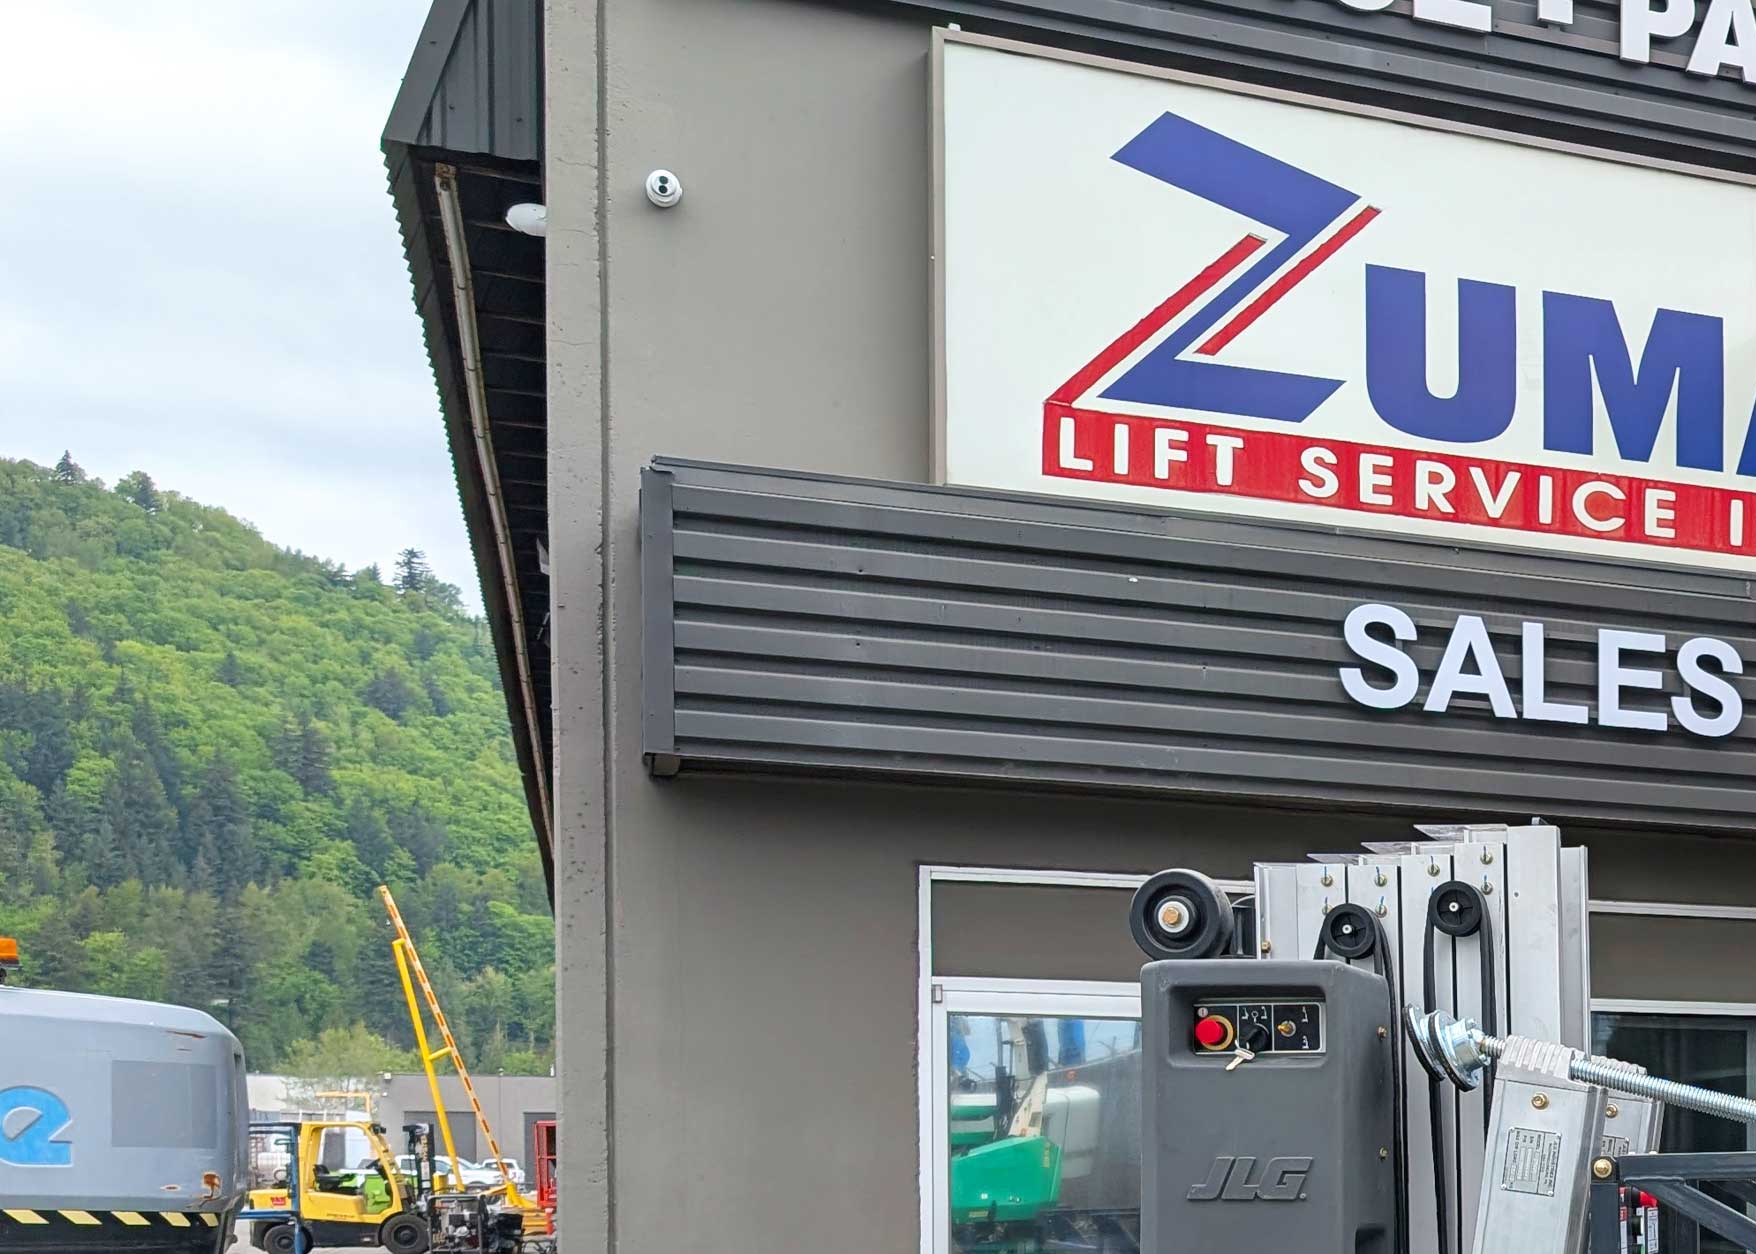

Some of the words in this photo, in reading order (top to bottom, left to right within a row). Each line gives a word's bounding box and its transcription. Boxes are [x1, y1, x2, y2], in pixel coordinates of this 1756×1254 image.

[1058, 416, 1245, 488] LIFT
[1297, 446, 1678, 538] SERVICE
[1338, 603, 1744, 738] SALES
[1186, 1155, 1314, 1202] JLG
